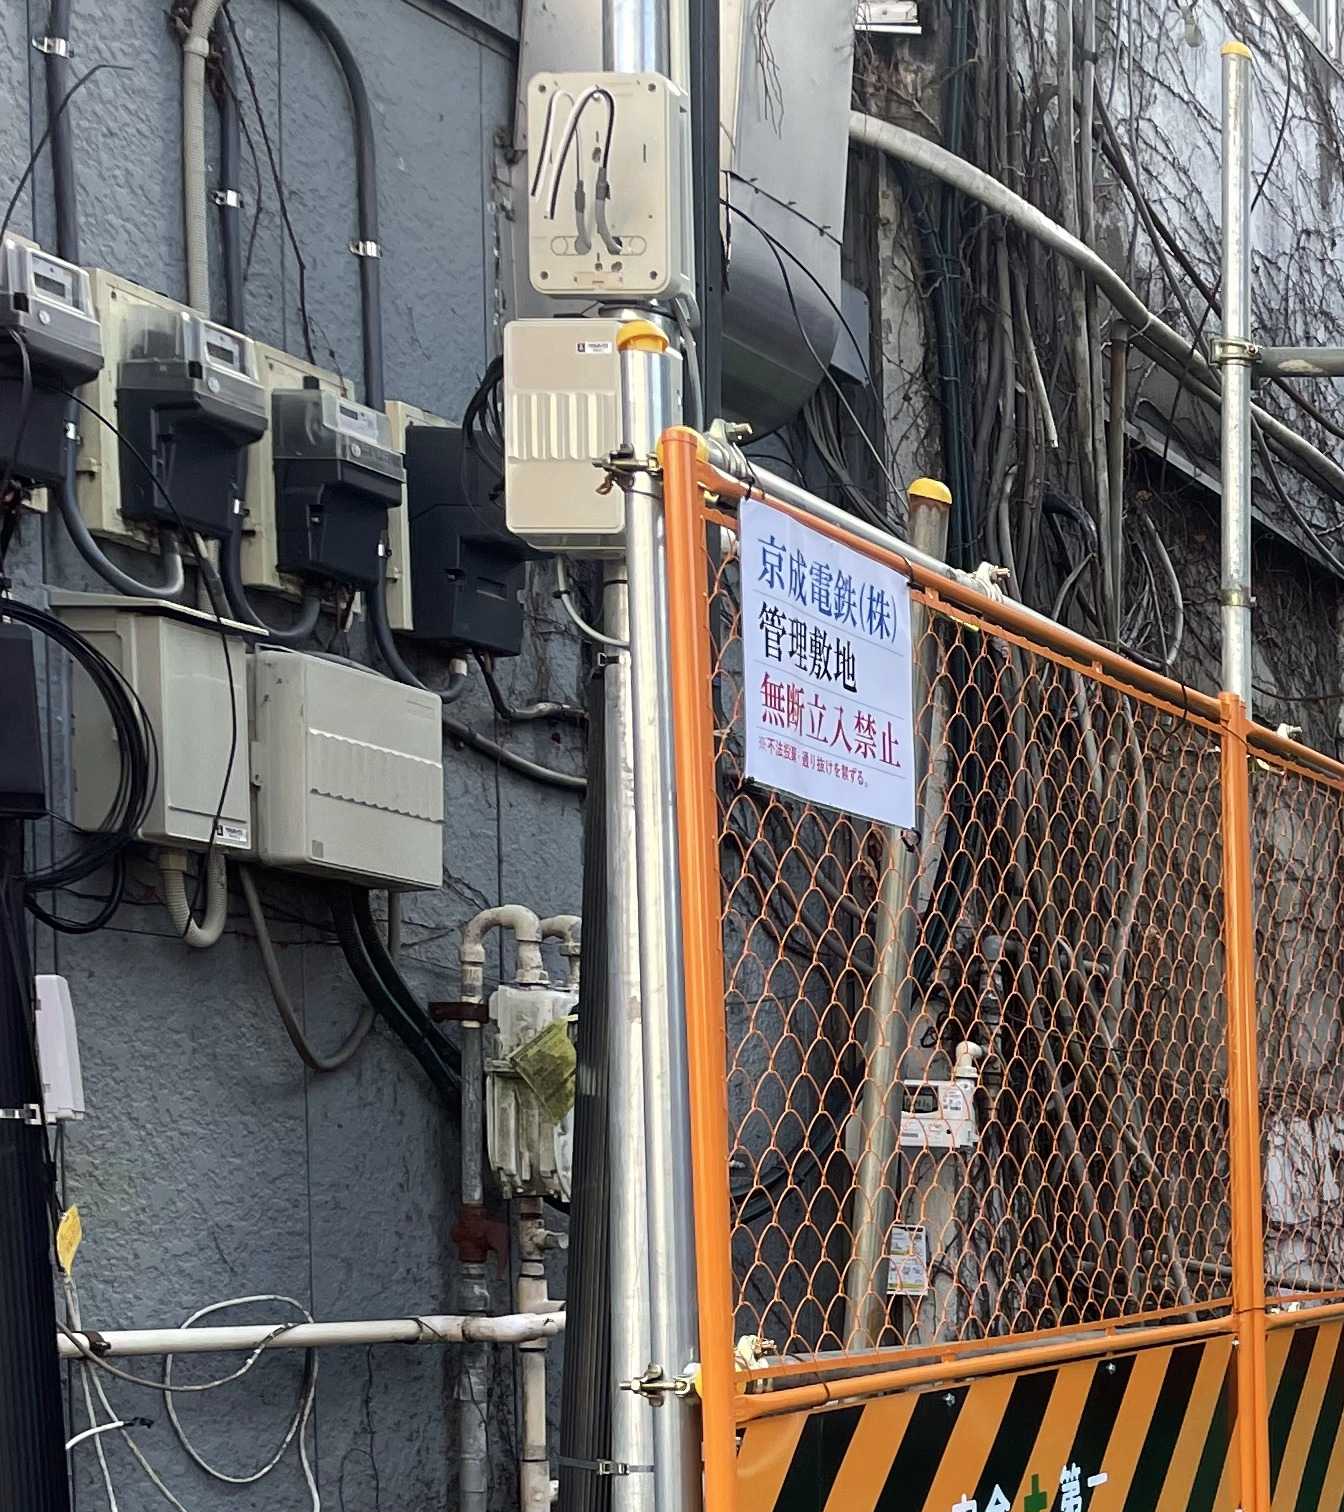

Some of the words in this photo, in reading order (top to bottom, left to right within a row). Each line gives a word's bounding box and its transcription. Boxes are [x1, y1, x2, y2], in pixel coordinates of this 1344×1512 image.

[758, 535, 897, 643] 京成電鉄(株)
[758, 602, 857, 692] 管理敷地
[761, 672, 900, 768] 無断立入禁止
